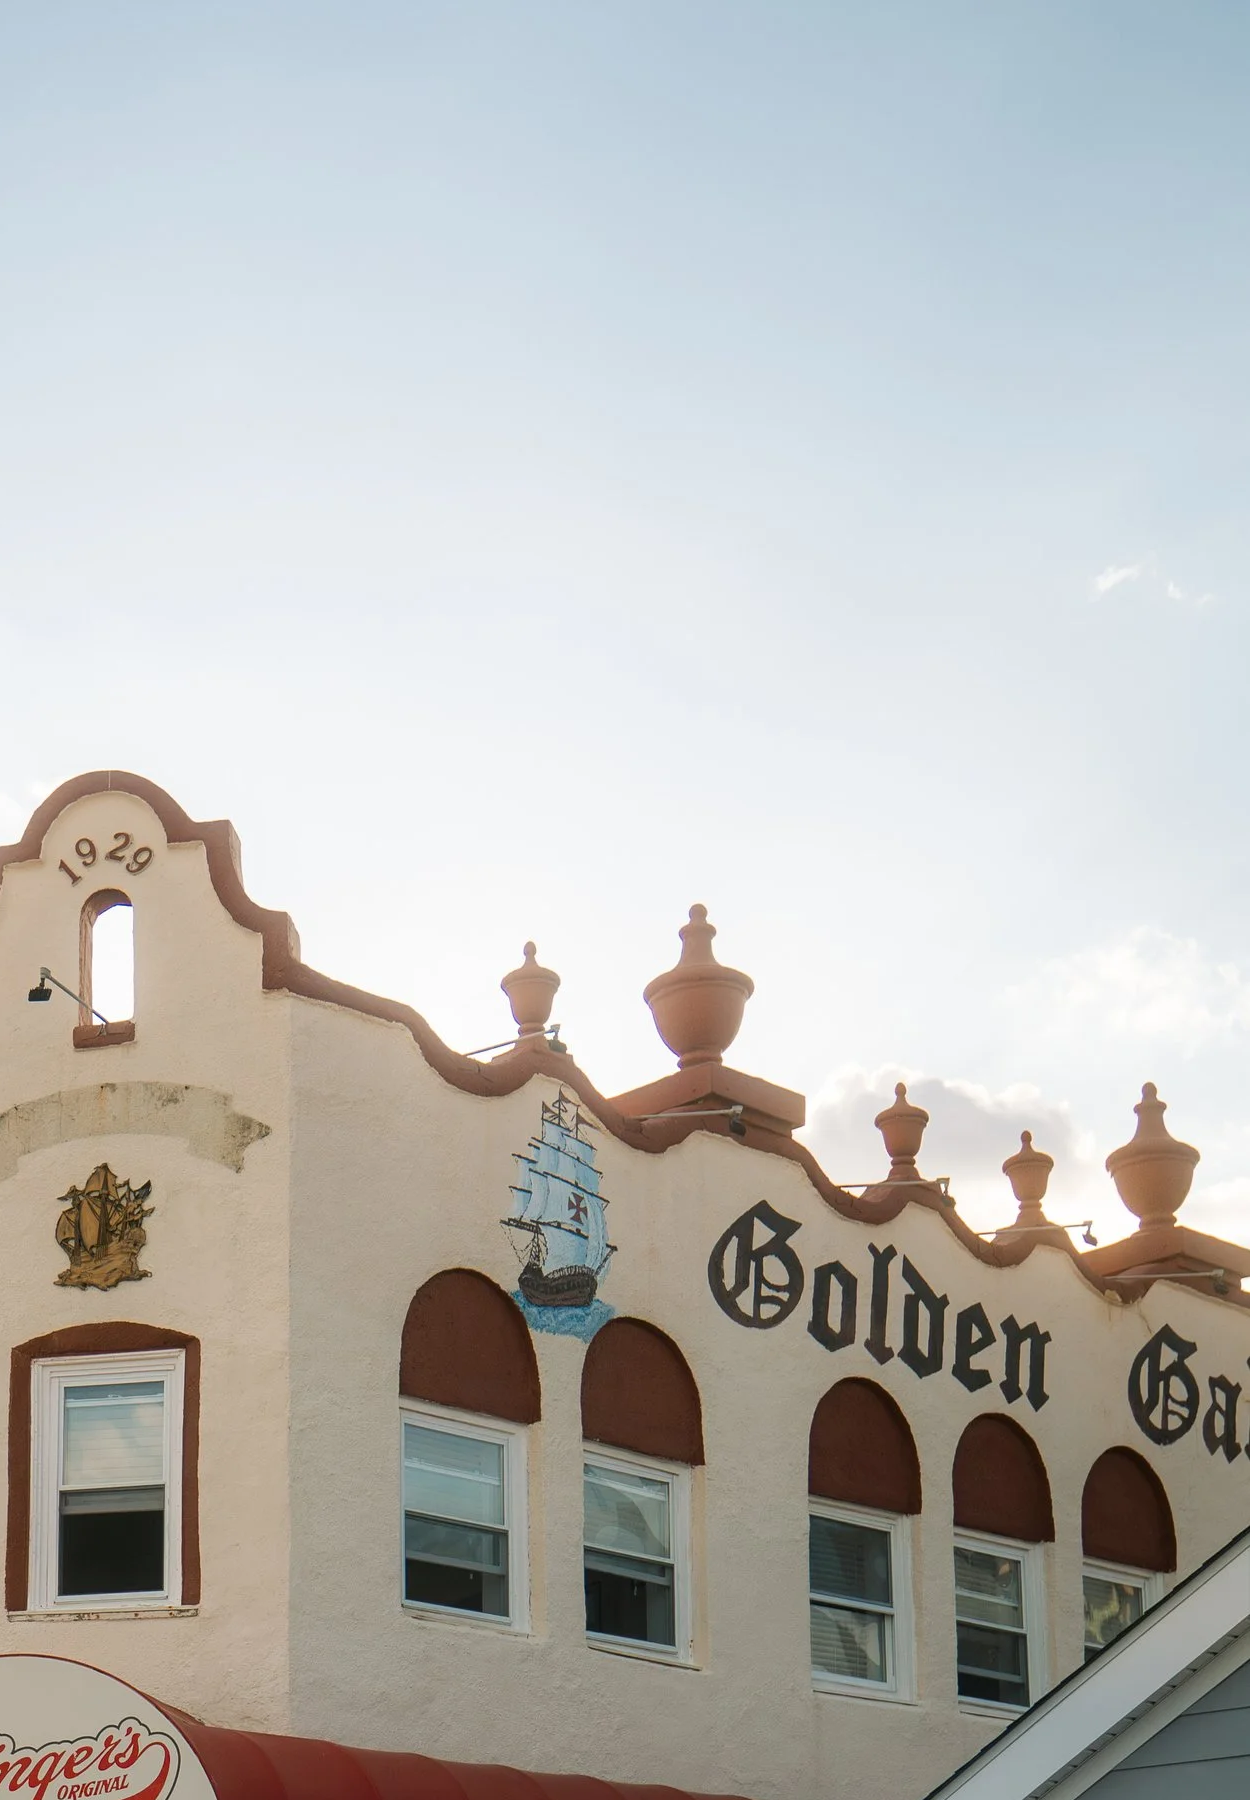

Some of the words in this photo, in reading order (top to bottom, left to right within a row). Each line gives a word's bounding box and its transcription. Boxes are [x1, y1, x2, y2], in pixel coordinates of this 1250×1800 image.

[58, 832, 154, 886] 1929
[707, 1199, 1052, 1412] Golden
[1129, 1323, 1250, 1464] Ga
